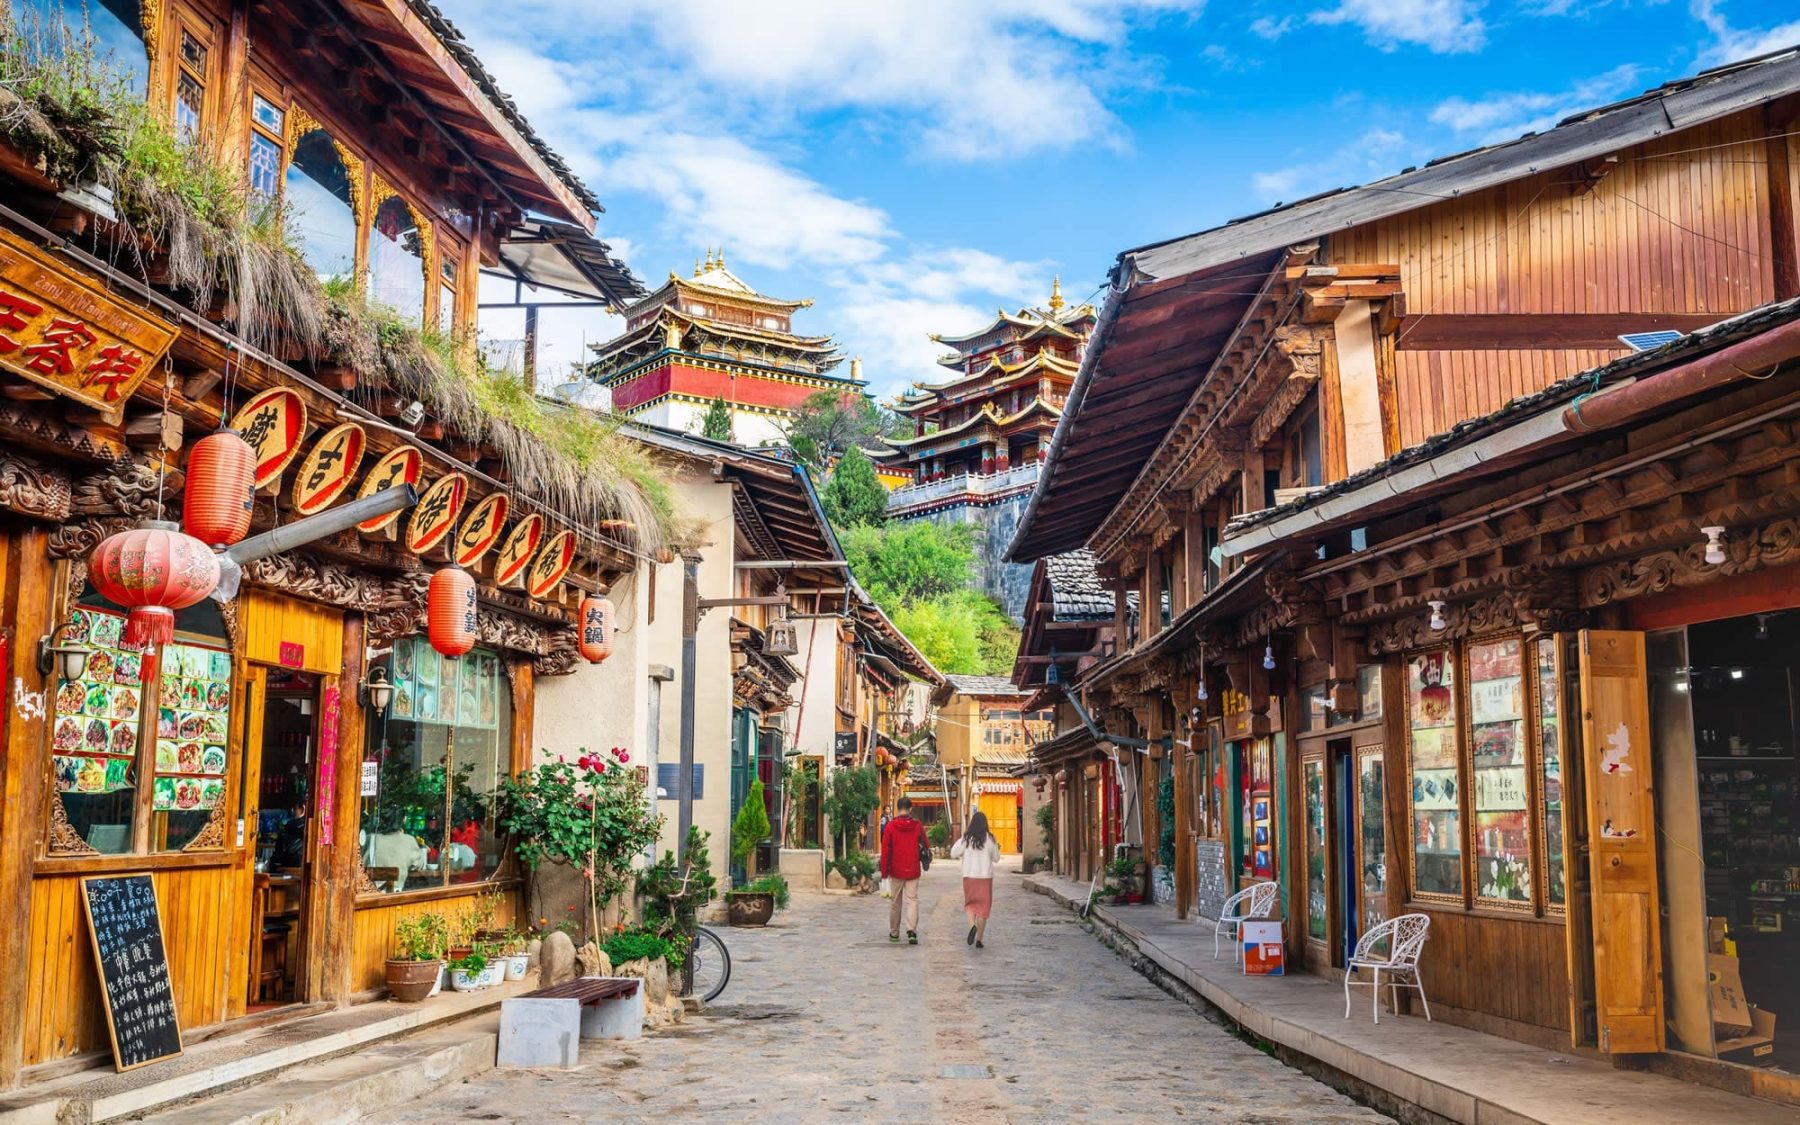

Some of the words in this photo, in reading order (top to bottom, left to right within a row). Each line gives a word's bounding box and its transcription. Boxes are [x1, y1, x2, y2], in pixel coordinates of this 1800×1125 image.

[76, 295, 108, 321] Wang
[416, 486, 453, 536] 特
[462, 503, 492, 548] 色
[503, 524, 529, 562] 火
